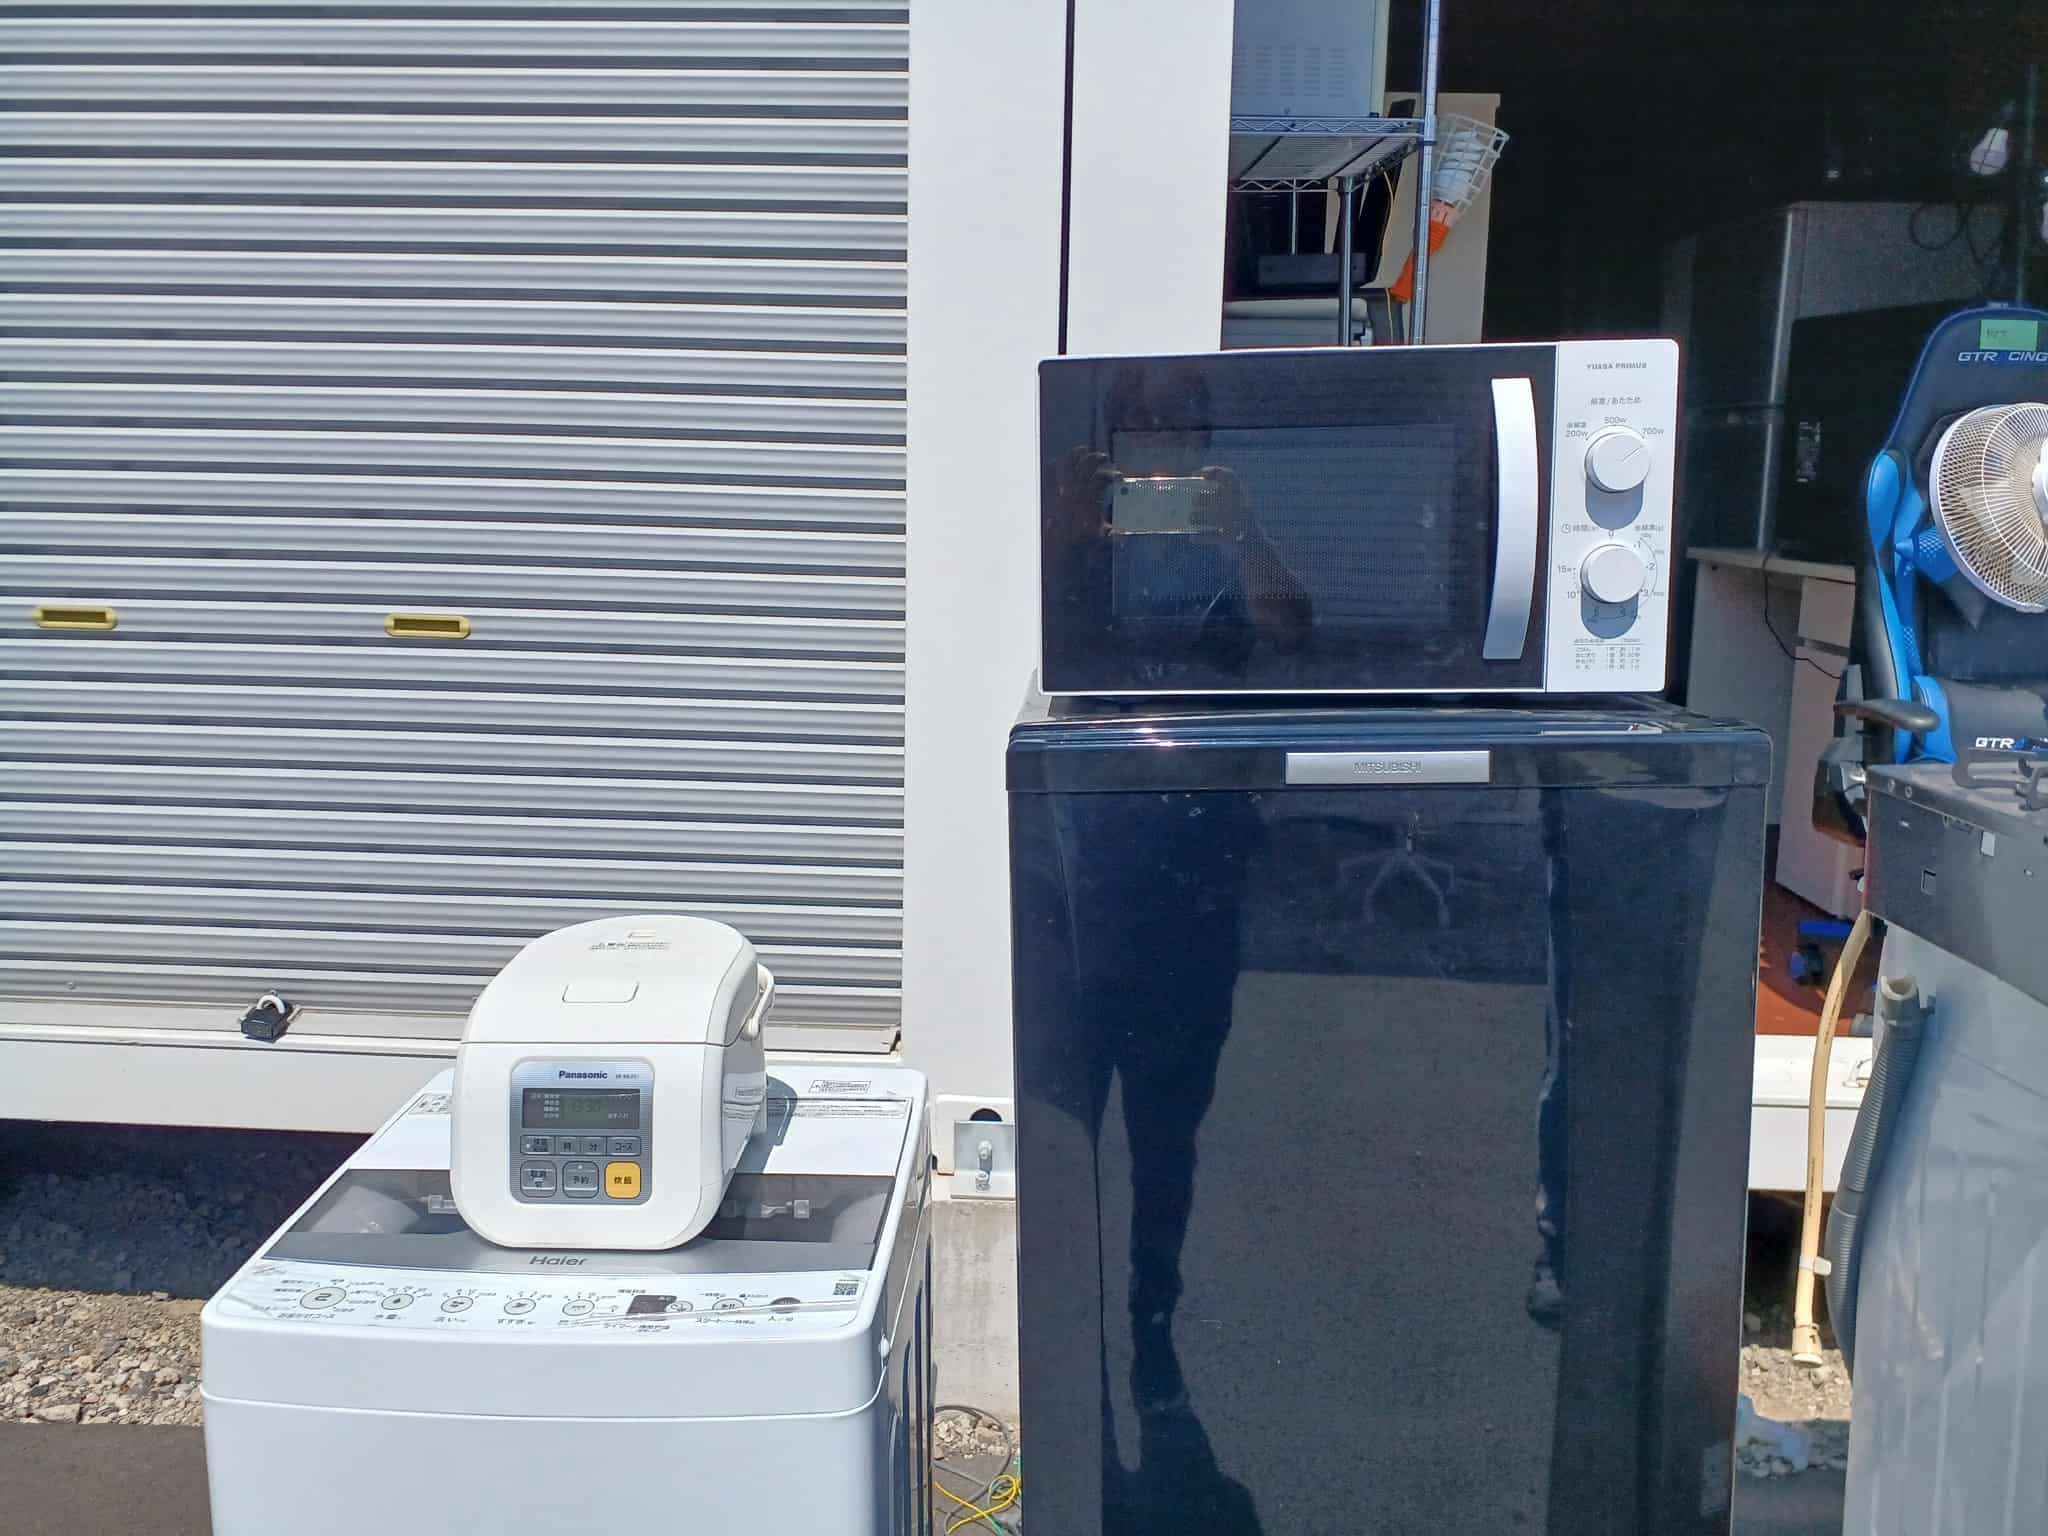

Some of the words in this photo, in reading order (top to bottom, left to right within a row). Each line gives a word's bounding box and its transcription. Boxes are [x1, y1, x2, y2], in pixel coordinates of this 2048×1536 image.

[1352, 759, 1425, 775] MITSUBISHI
[558, 1070, 609, 1080] Panasonic
[529, 1255, 588, 1267] Haier
